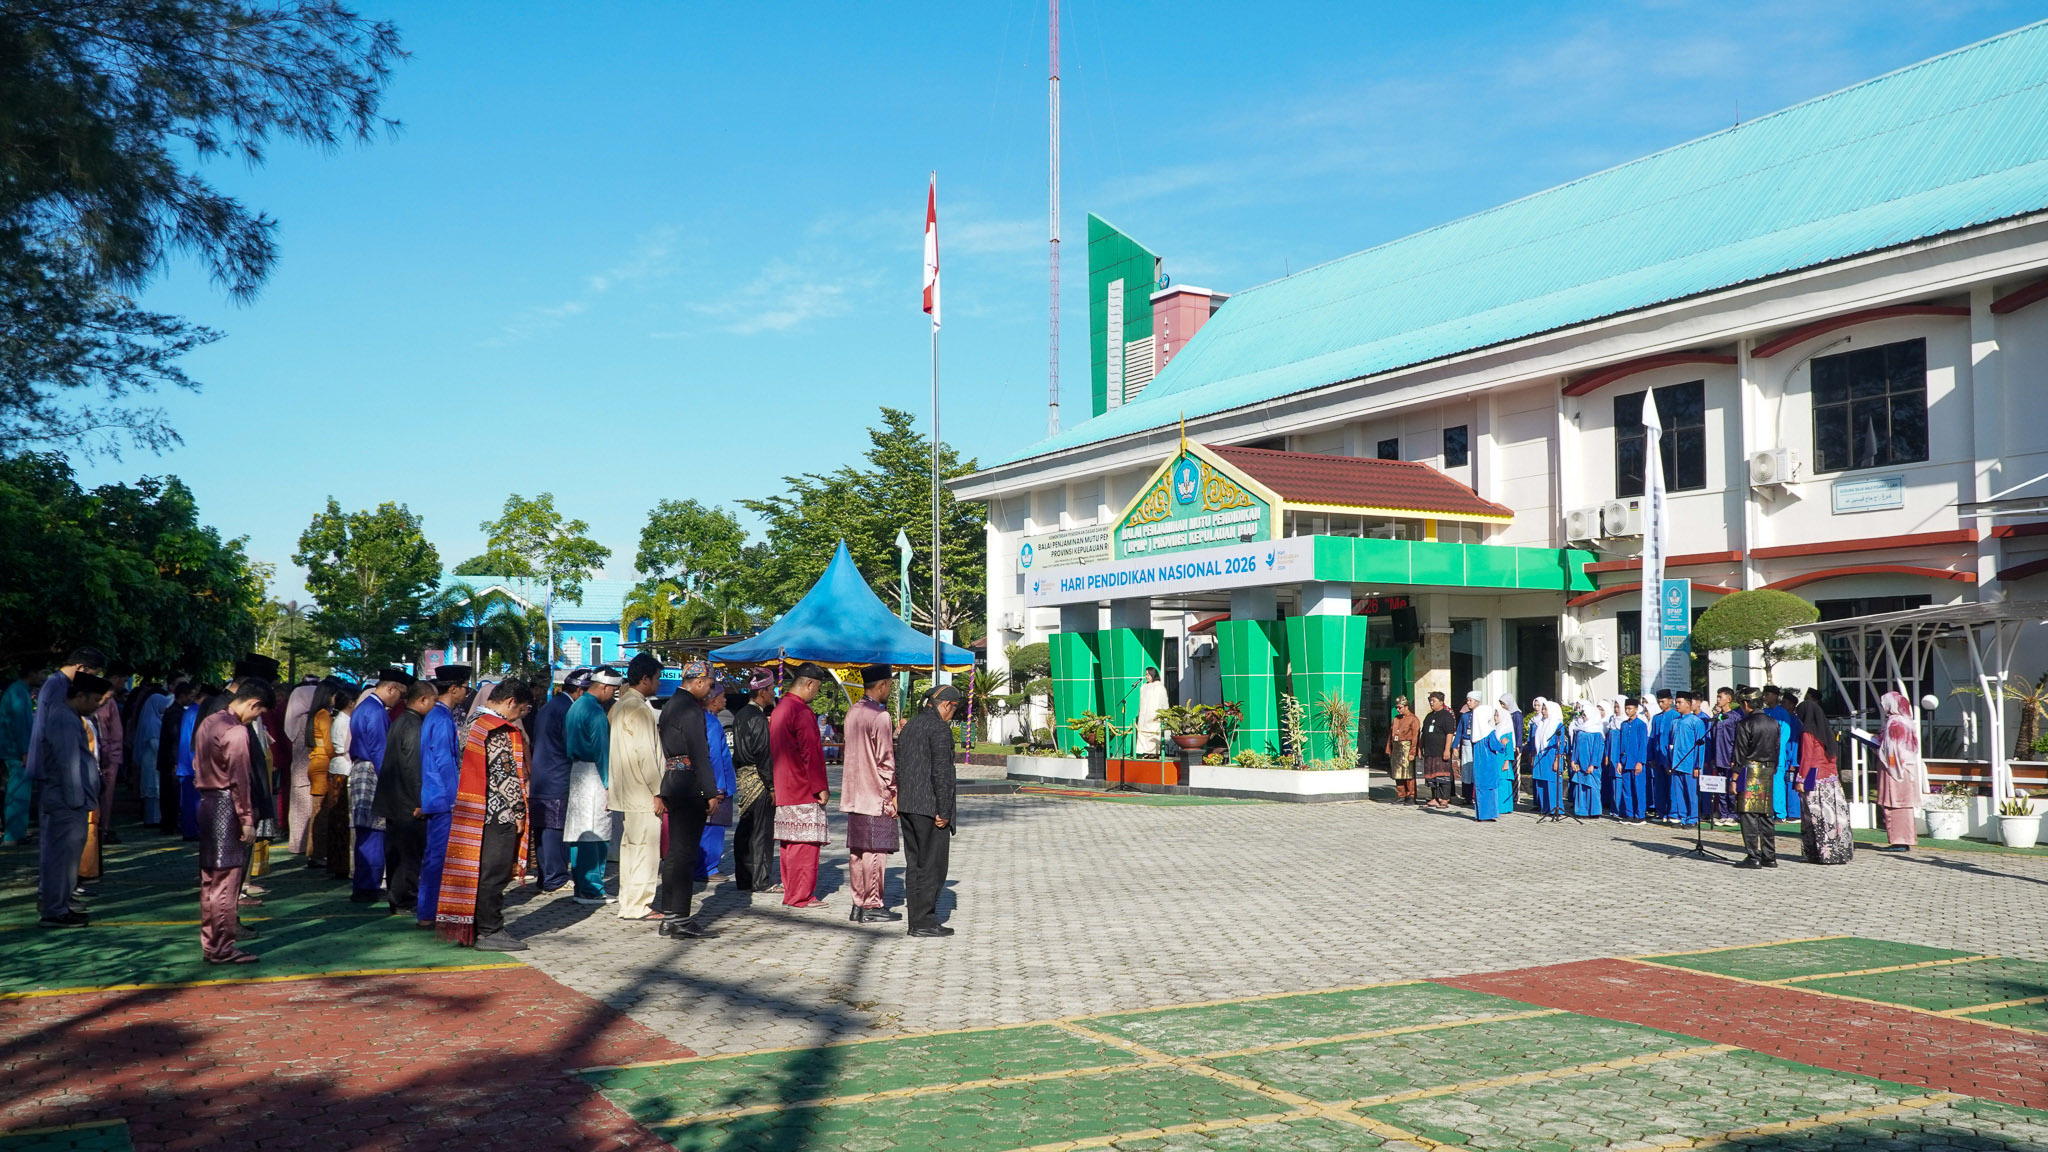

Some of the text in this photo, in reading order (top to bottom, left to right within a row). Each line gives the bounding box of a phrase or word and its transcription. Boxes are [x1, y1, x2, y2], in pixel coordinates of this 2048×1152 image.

[1122, 507, 1260, 541] BALAI PENJAMINAN MUTU PENDIDIKAN
[1038, 542, 1051, 551] BALAI
[1052, 538, 1084, 549] PENJAMINAN
[1084, 535, 1099, 544] MUTU
[1153, 533, 1188, 550] PROVINSI
[1188, 526, 1236, 545] KEPULAUAN
[1237, 522, 1258, 538] RIAU
[1051, 547, 1074, 557] PROVINSI
[1074, 544, 1104, 555] KEPULAUAN
[1060, 576, 1085, 593] HARI
[1087, 568, 1155, 590] PENDIDIKAN
[1159, 560, 1222, 581] NASIONAL
[1225, 556, 1257, 575] 2026
[1352, 598, 1379, 615] 2026
[1664, 636, 1672, 648] 10
